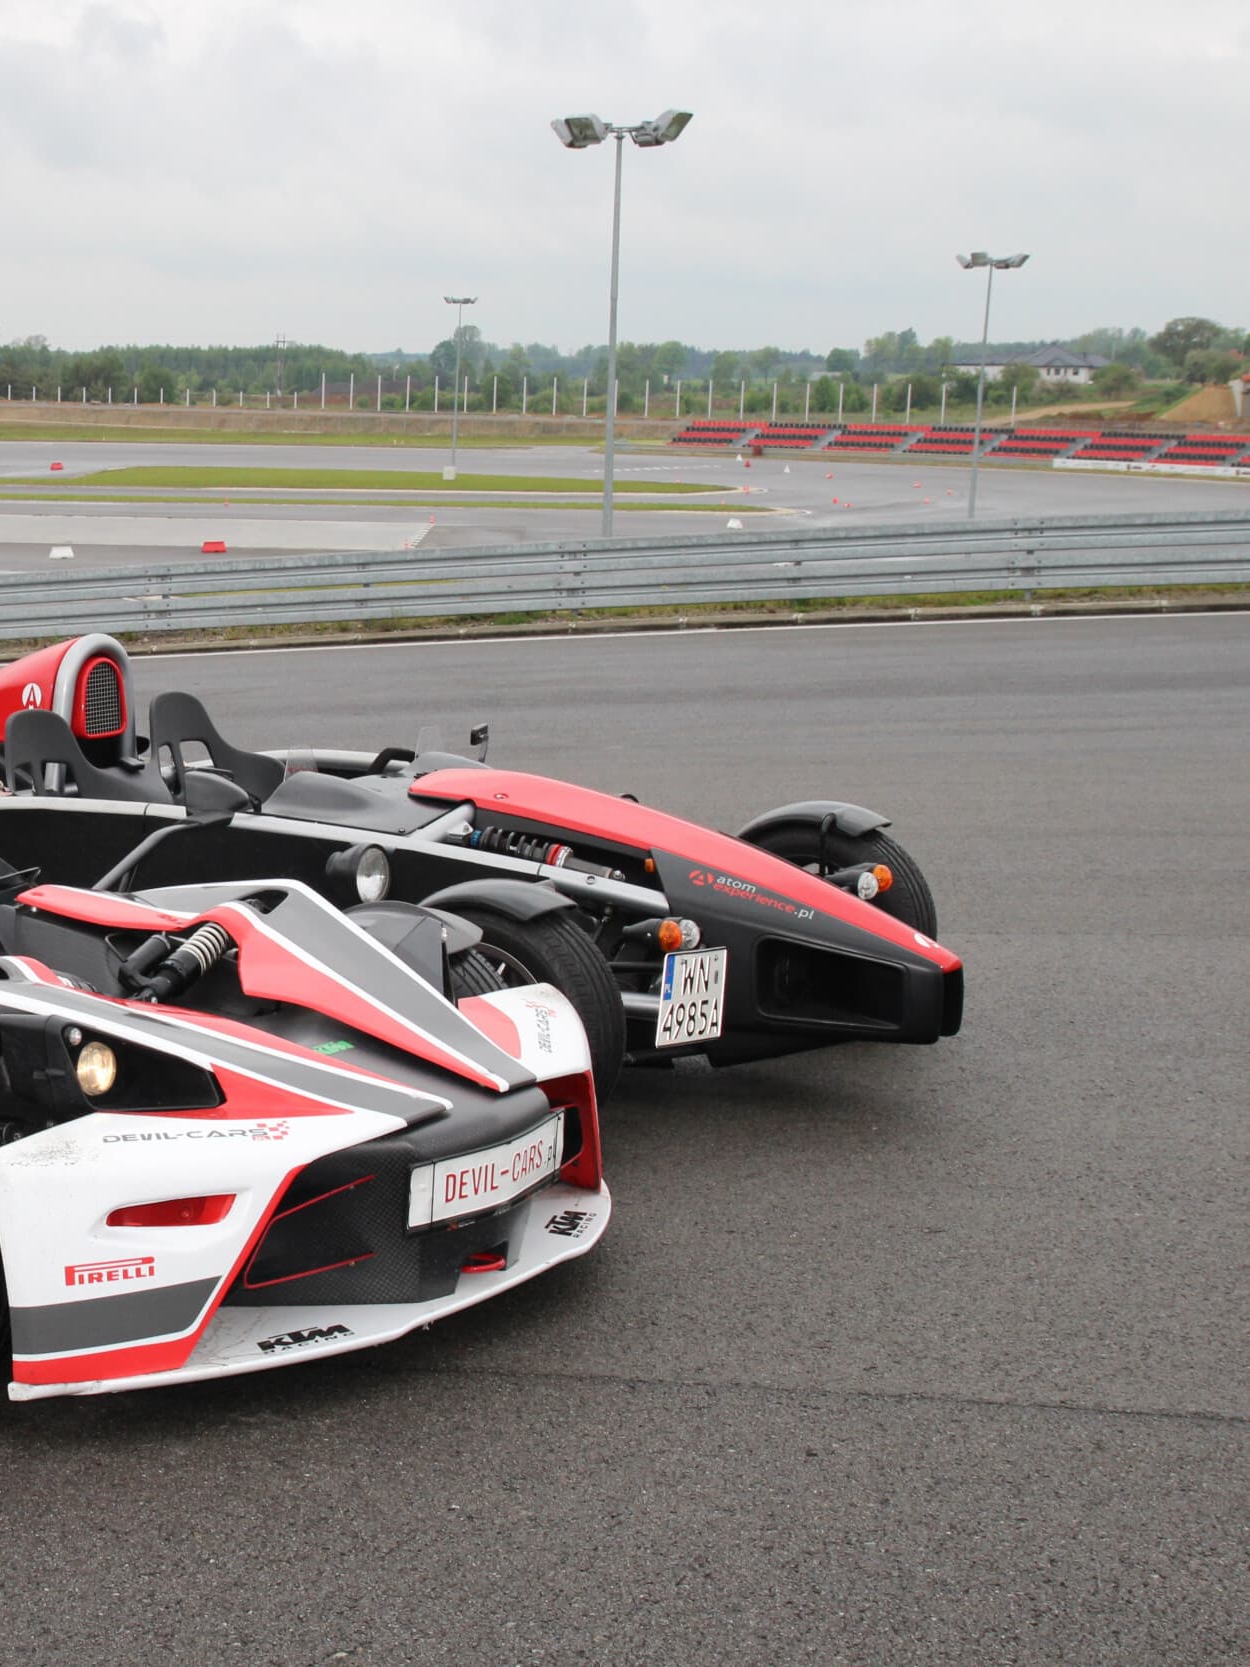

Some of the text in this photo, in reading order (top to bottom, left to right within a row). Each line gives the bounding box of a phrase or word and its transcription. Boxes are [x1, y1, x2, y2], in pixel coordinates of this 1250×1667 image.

[716, 876, 756, 893] atom
[713, 883, 815, 919] experience.pl
[681, 955, 711, 996] WN
[661, 998, 719, 1041] 4985A
[102, 1129, 268, 1143] DEVIL-CARS
[544, 1210, 588, 1237] KTM
[64, 1256, 155, 1286] PIRELLI
[256, 1323, 351, 1351] KTM
